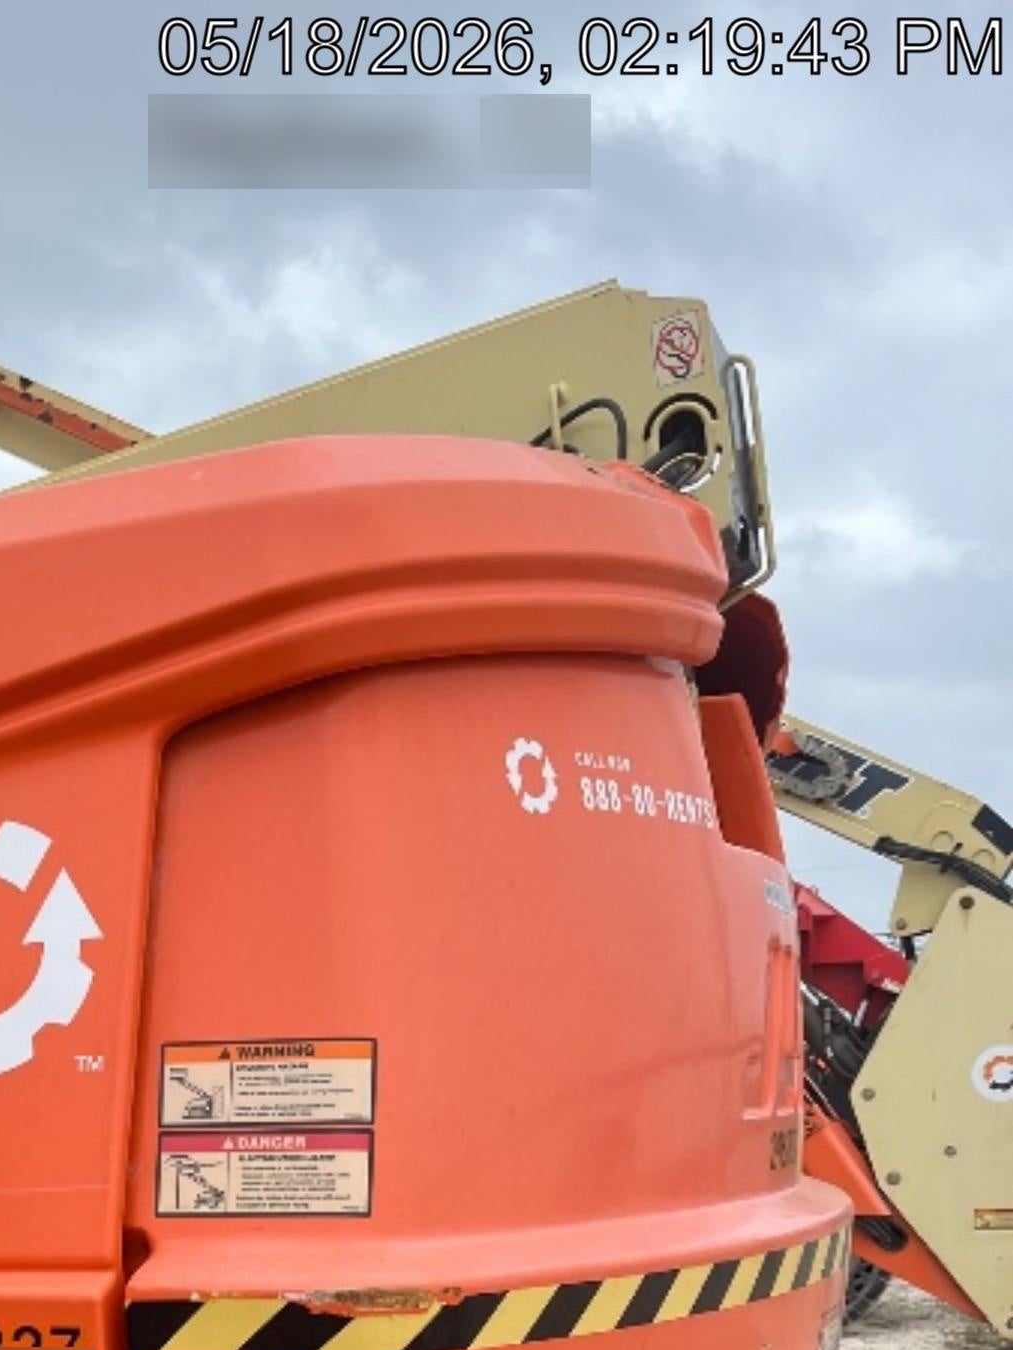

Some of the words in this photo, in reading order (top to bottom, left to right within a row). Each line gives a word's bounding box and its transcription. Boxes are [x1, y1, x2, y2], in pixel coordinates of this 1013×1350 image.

[236, 1043, 316, 1060] WARNING
[73, 1054, 105, 1073] TM
[238, 1136, 307, 1150] DANGER
